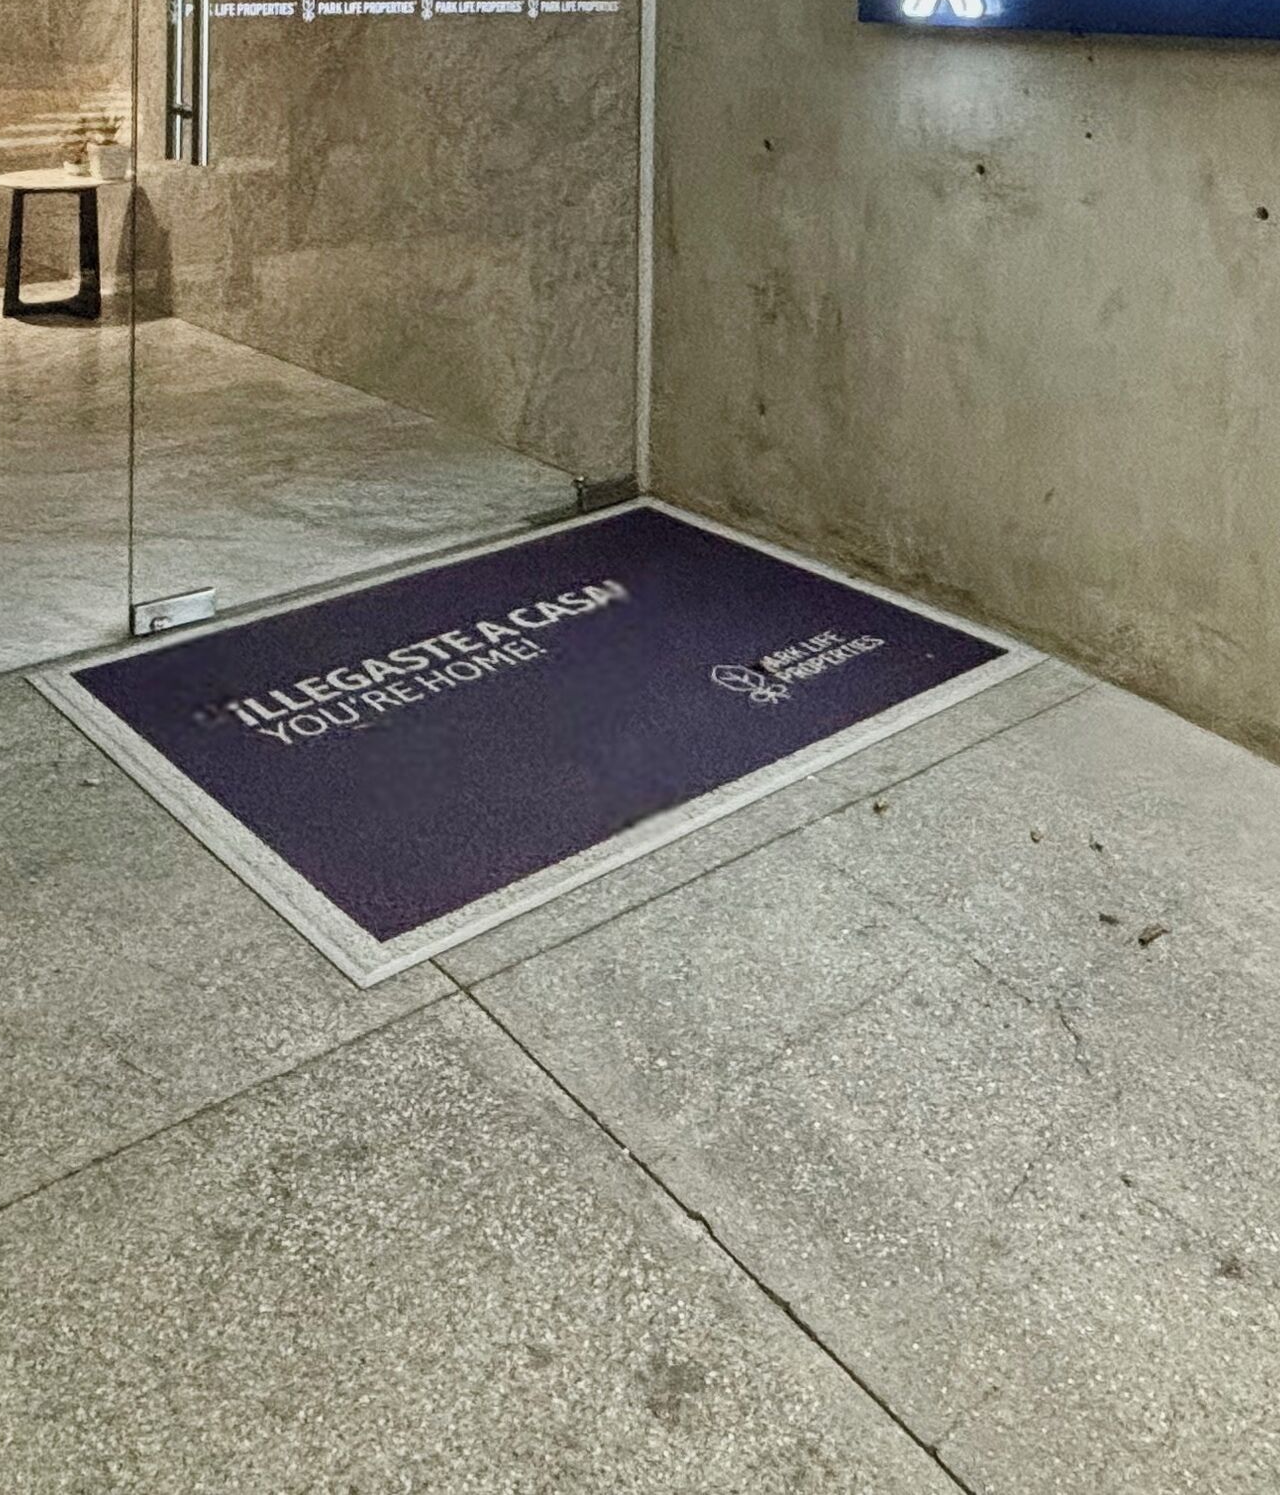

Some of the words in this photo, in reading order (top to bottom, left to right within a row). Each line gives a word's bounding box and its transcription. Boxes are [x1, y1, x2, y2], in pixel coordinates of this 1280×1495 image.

[215, 2, 236, 16] LIFE
[318, 2, 343, 14] PARK
[344, 2, 362, 14] LIFE
[476, 621, 521, 643] A
[774, 635, 885, 684] PROPERTIES
[258, 680, 424, 745] YOU'RE
[415, 637, 548, 693] HOME!
